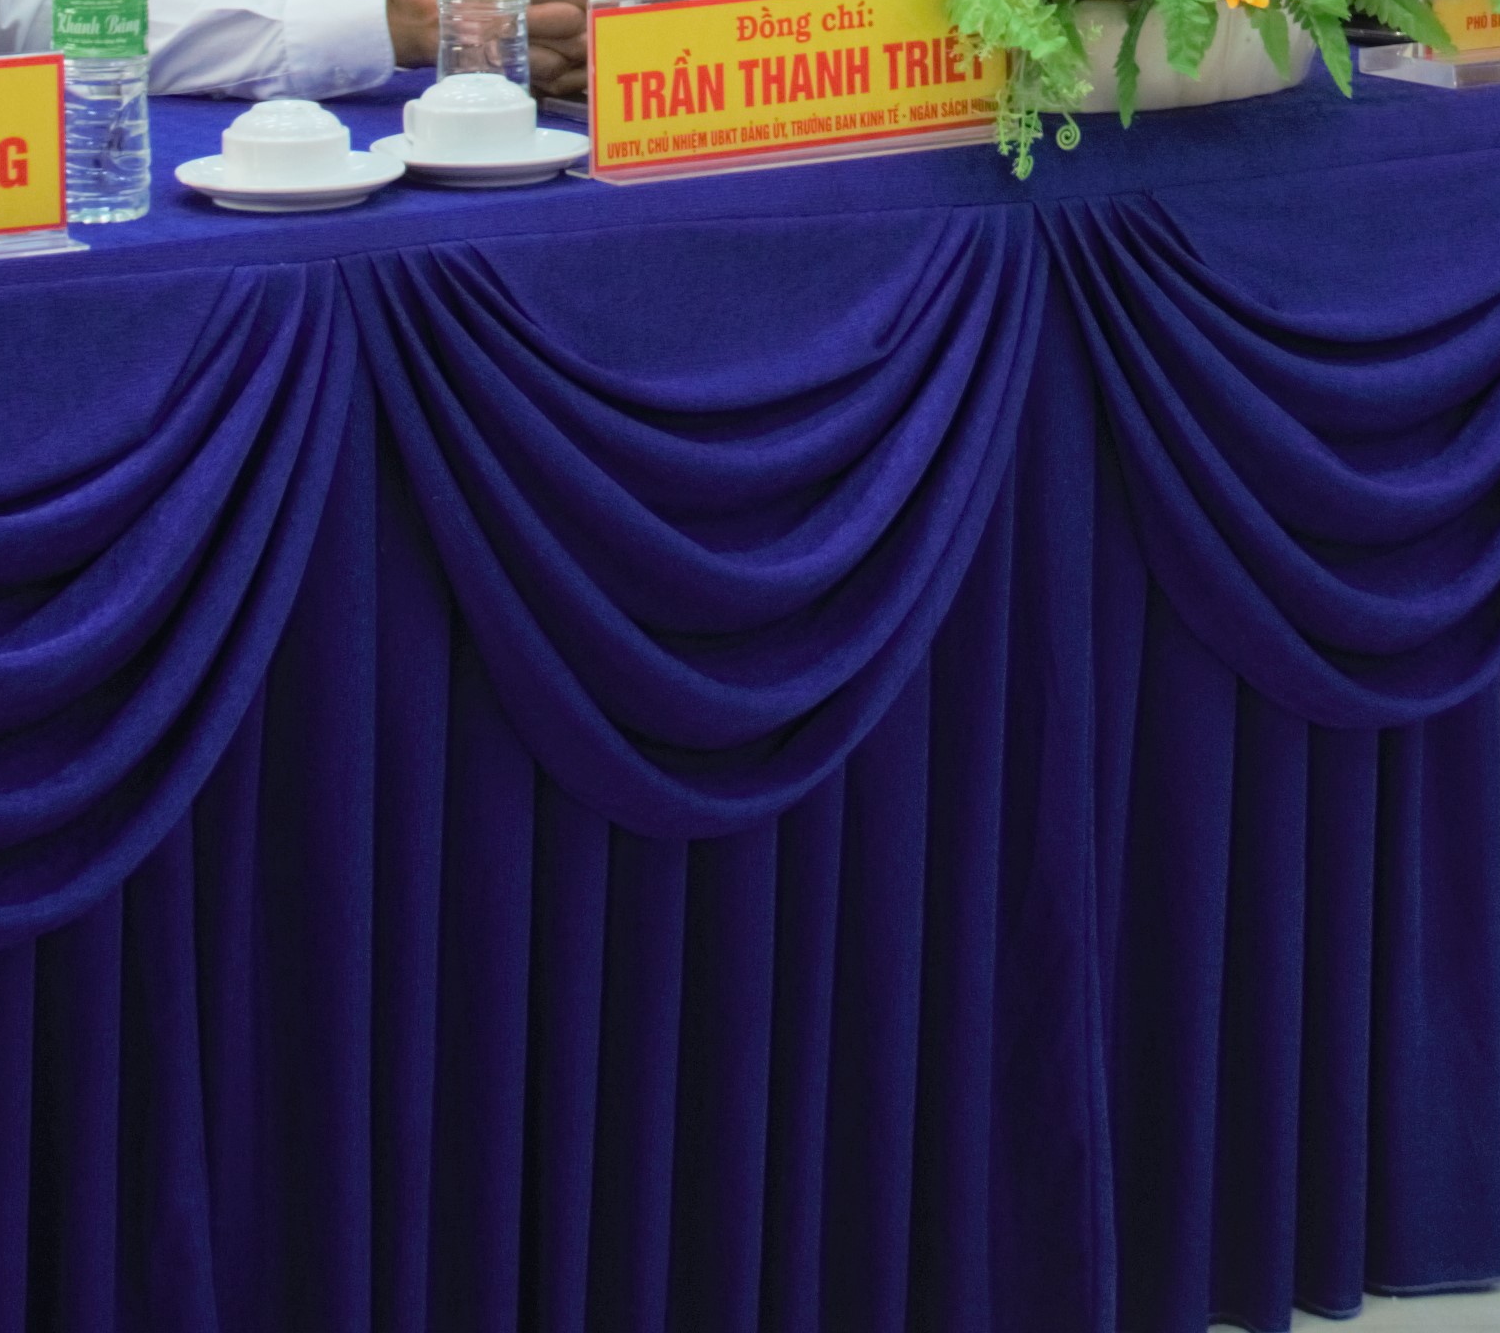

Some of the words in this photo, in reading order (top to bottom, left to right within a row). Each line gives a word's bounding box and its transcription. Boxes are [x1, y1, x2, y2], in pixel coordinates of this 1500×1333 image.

[736, 6, 812, 43] Đồng
[821, 0, 874, 32] chí:
[1467, 11, 1487, 30] PHÓ
[617, 48, 725, 123] TRẦN
[738, 46, 870, 108] THANH
[607, 138, 645, 160] UVBTV,
[647, 129, 670, 155] CHỦ
[672, 128, 708, 154] NHIỆM
[710, 126, 737, 146] UBKT
[740, 118, 770, 142] ĐẢNG
[773, 116, 789, 140] ỦY,
[791, 111, 833, 136] TRƯỞNG
[835, 112, 857, 131] BAN
[859, 110, 885, 128] KINH
[887, 102, 900, 125] TẾ
[910, 102, 938, 122] NGÂN
[940, 98, 968, 119] SÁCH
